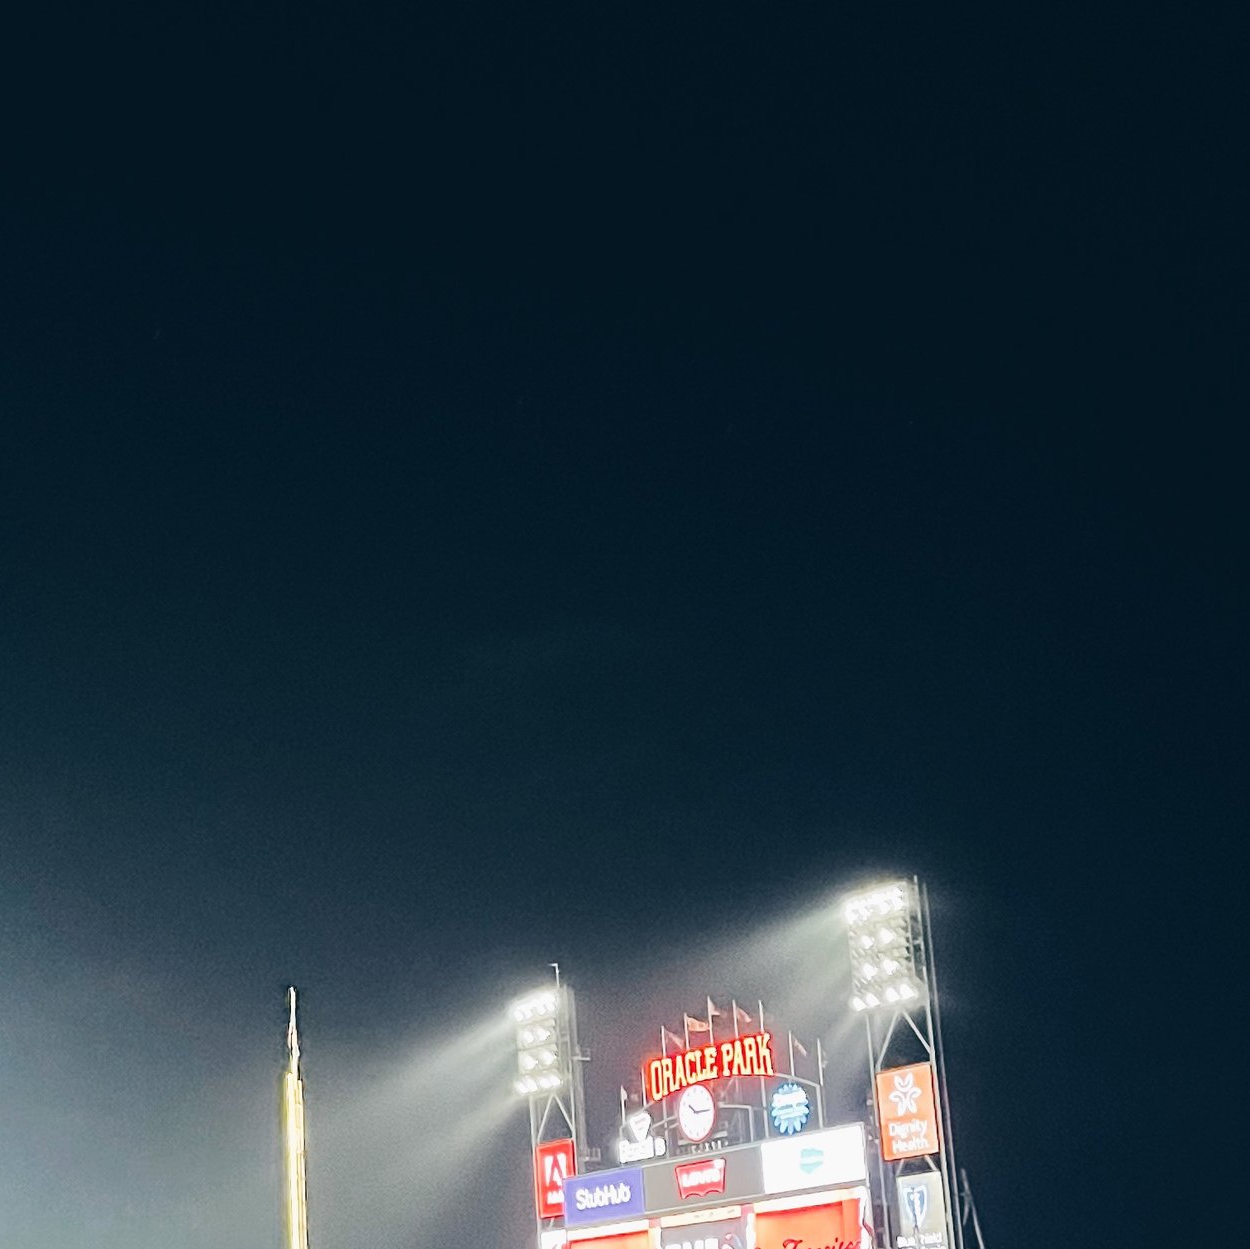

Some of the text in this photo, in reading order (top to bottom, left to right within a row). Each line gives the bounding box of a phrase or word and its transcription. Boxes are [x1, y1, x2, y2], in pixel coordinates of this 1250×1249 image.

[650, 1033, 774, 1102] ORACLE PARK
[889, 1118, 928, 1139] Dignity
[892, 1137, 929, 1154] Health
[575, 1181, 632, 1211] StubHub
